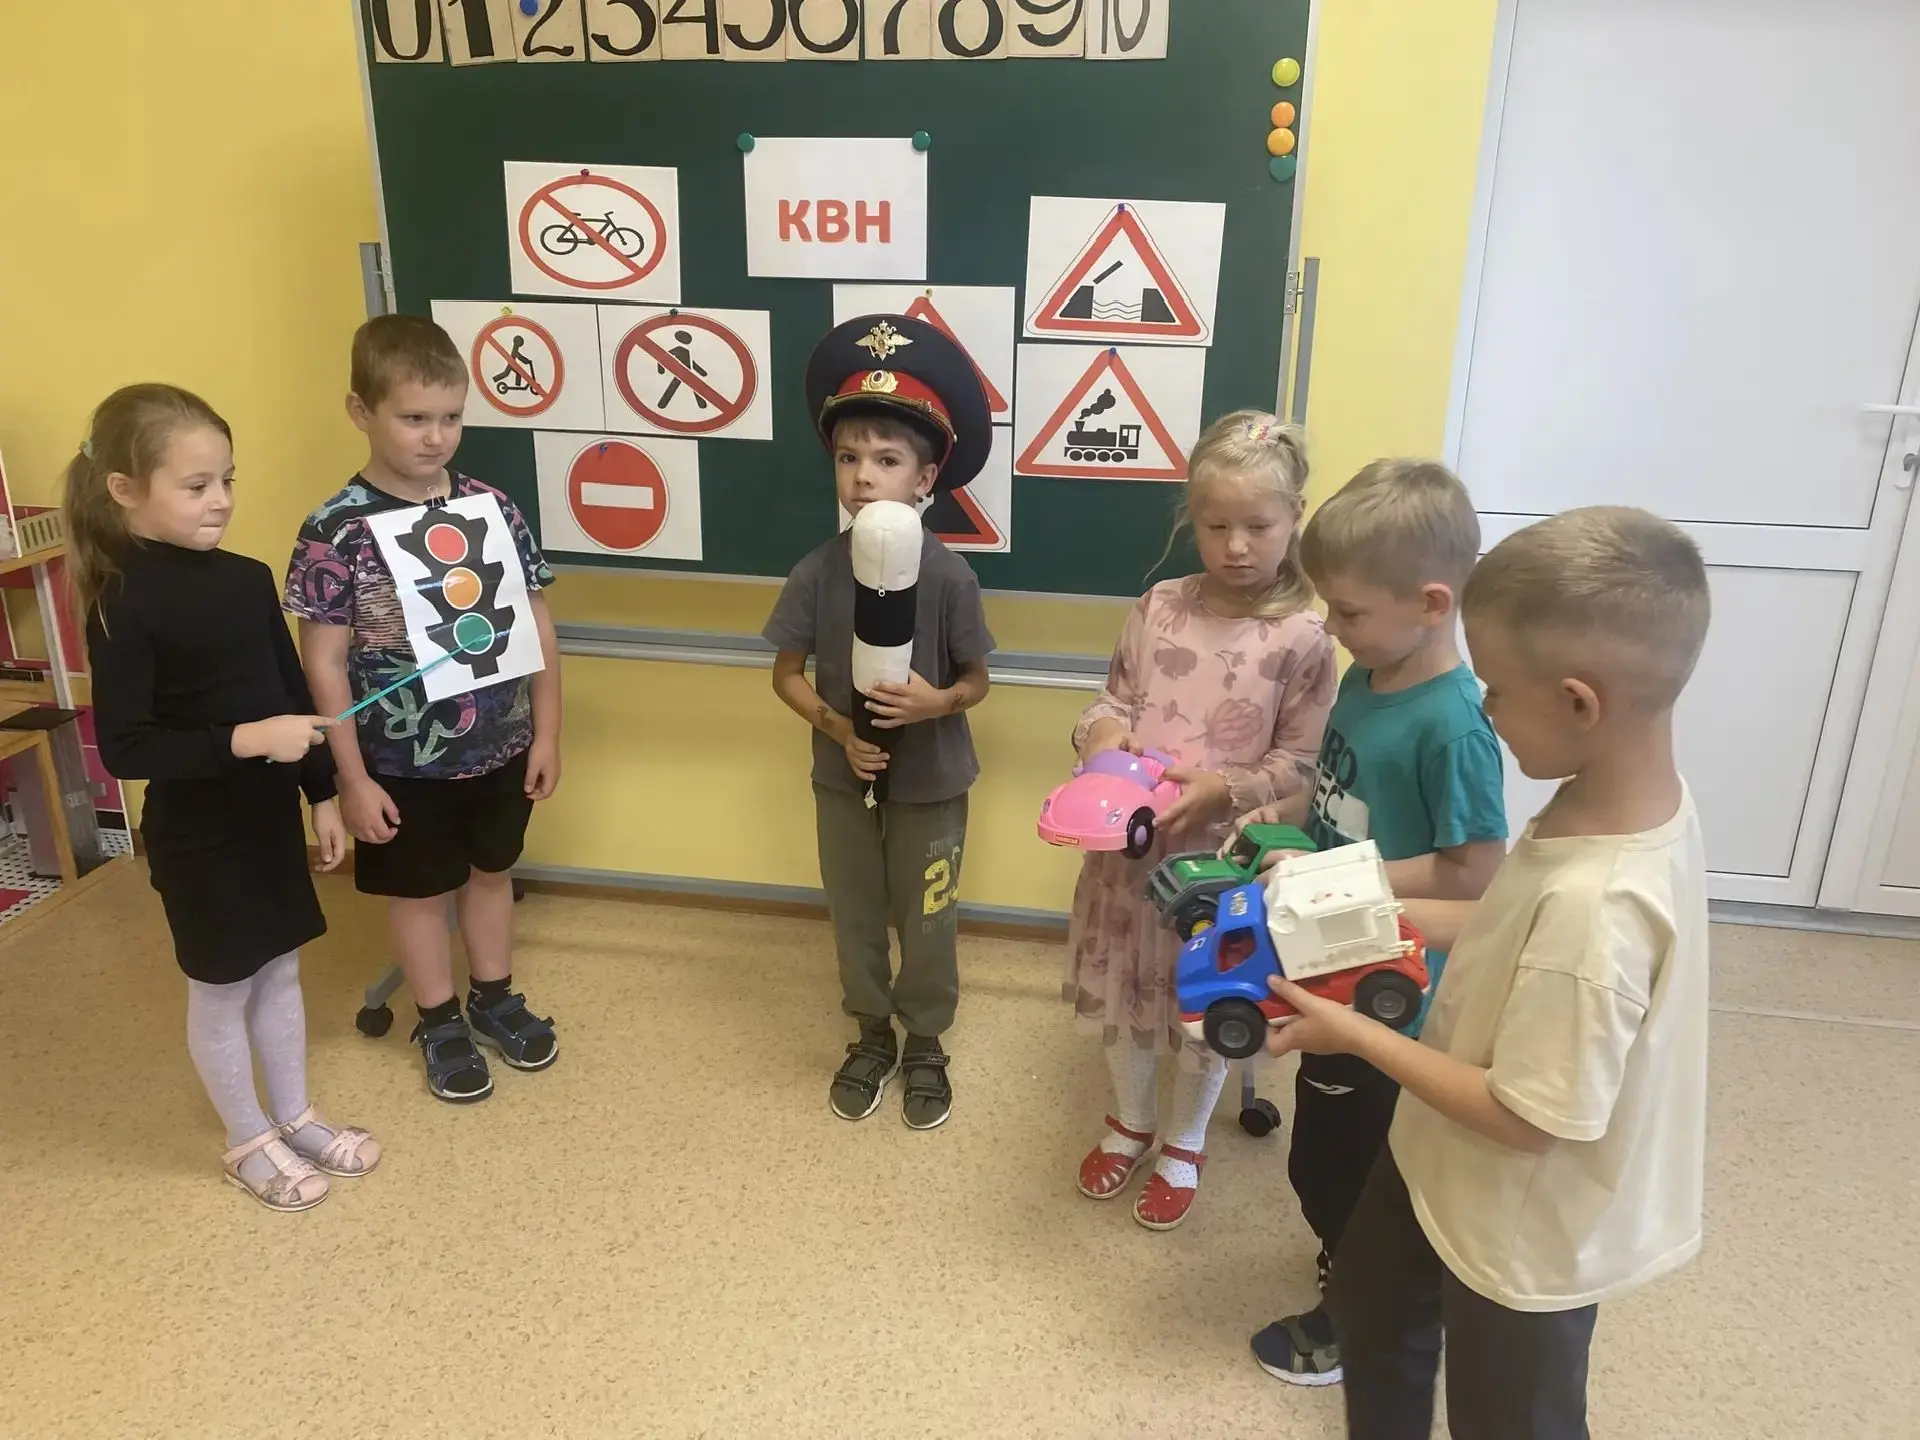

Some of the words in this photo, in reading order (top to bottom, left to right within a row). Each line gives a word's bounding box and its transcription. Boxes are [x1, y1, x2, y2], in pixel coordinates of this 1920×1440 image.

[447, 0, 495, 59] 1
[522, 0, 574, 57] 2
[778, 199, 891, 244] КВН
